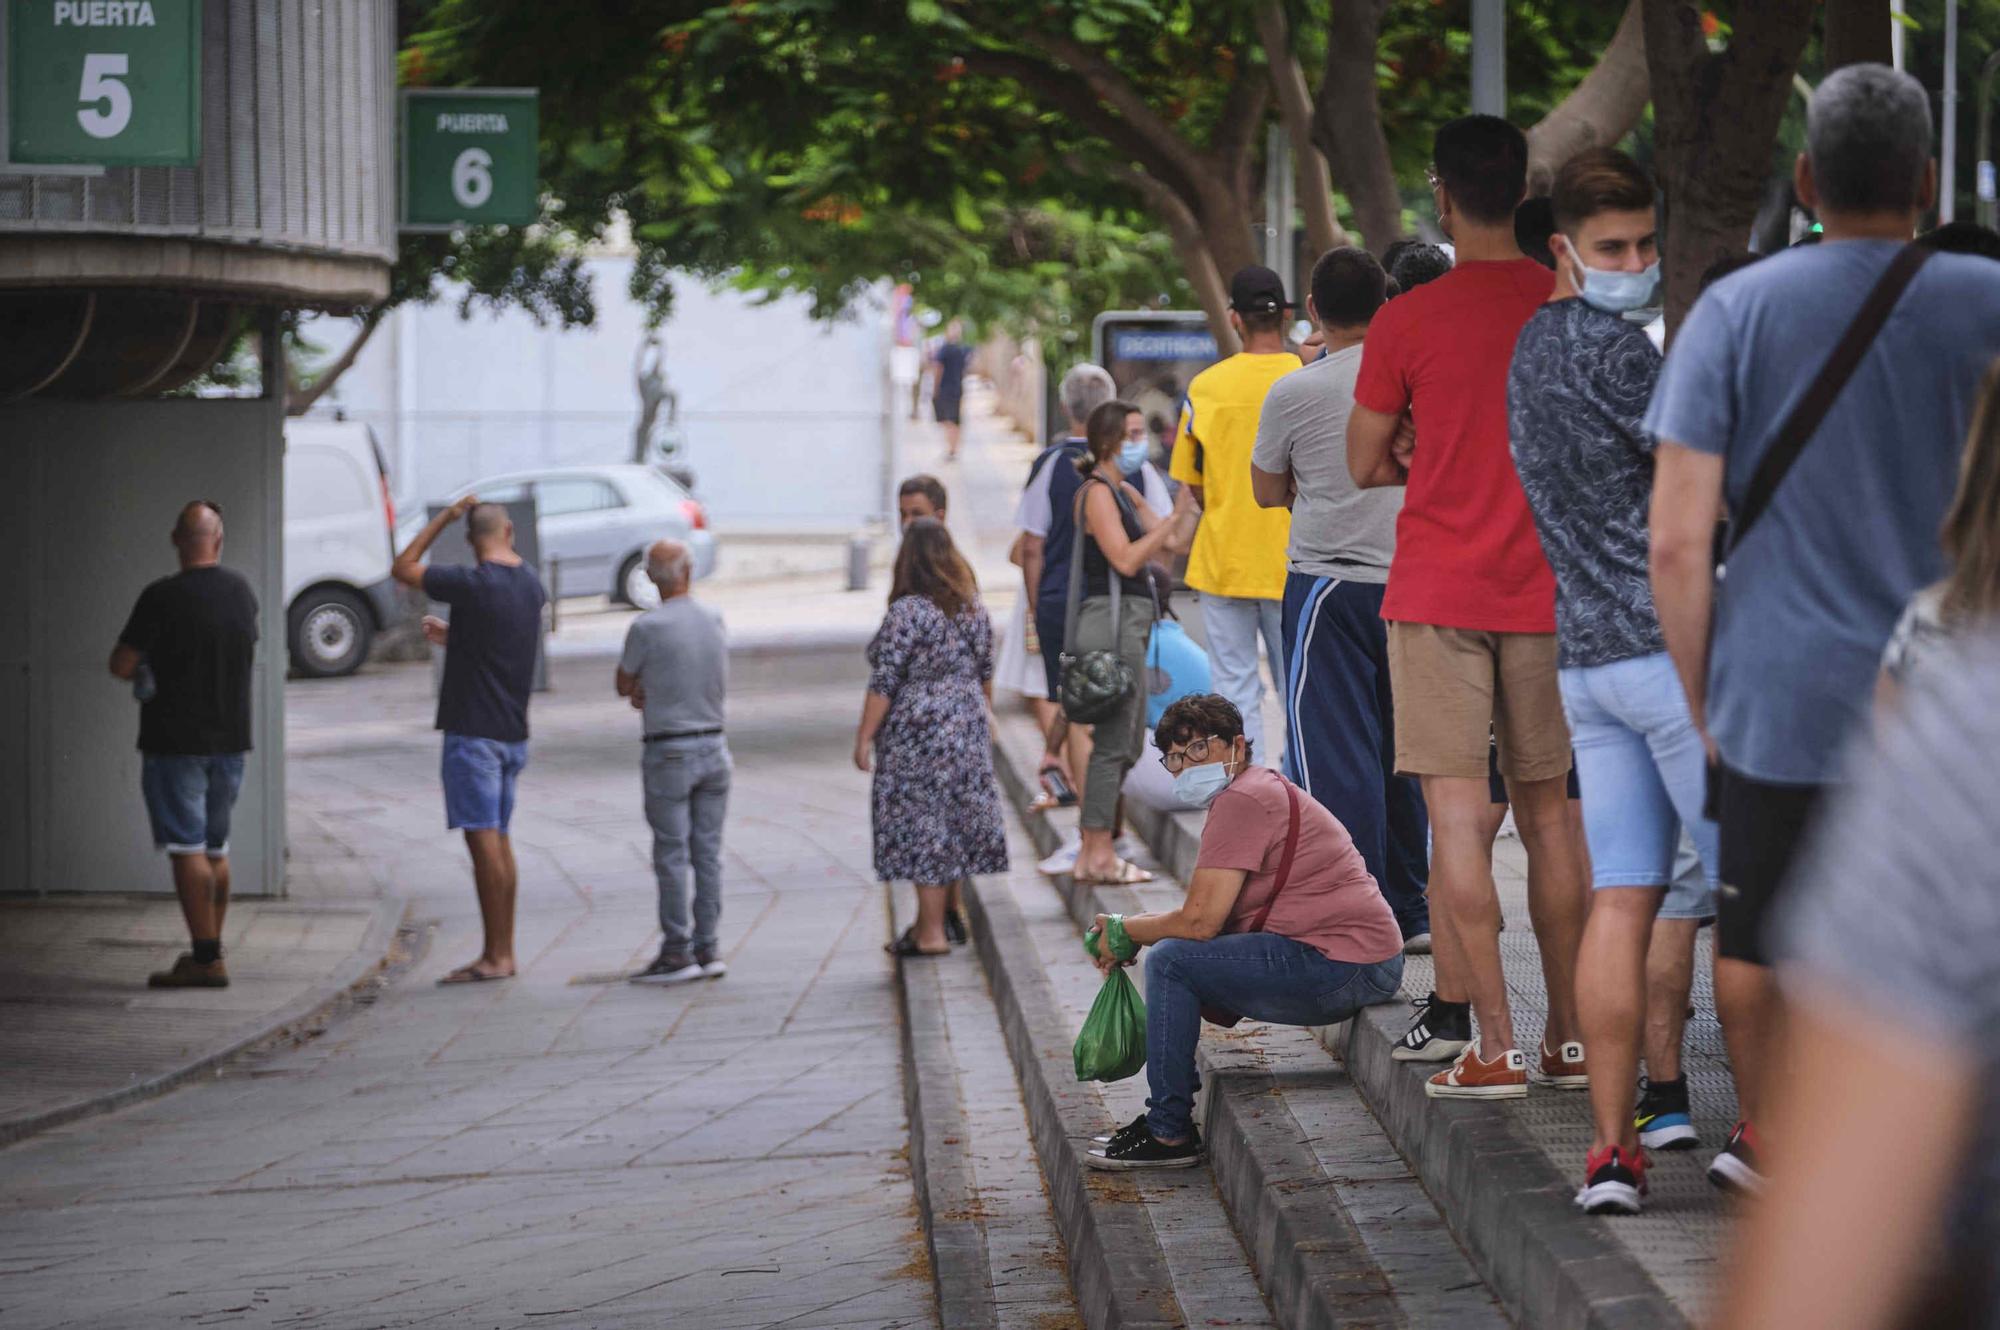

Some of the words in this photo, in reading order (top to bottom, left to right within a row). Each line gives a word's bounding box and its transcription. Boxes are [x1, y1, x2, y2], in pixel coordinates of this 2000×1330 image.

[54, 0, 156, 27] PUERTA
[77, 53, 132, 138] 5
[437, 113, 510, 134] PUERTA
[451, 147, 493, 209] 6
